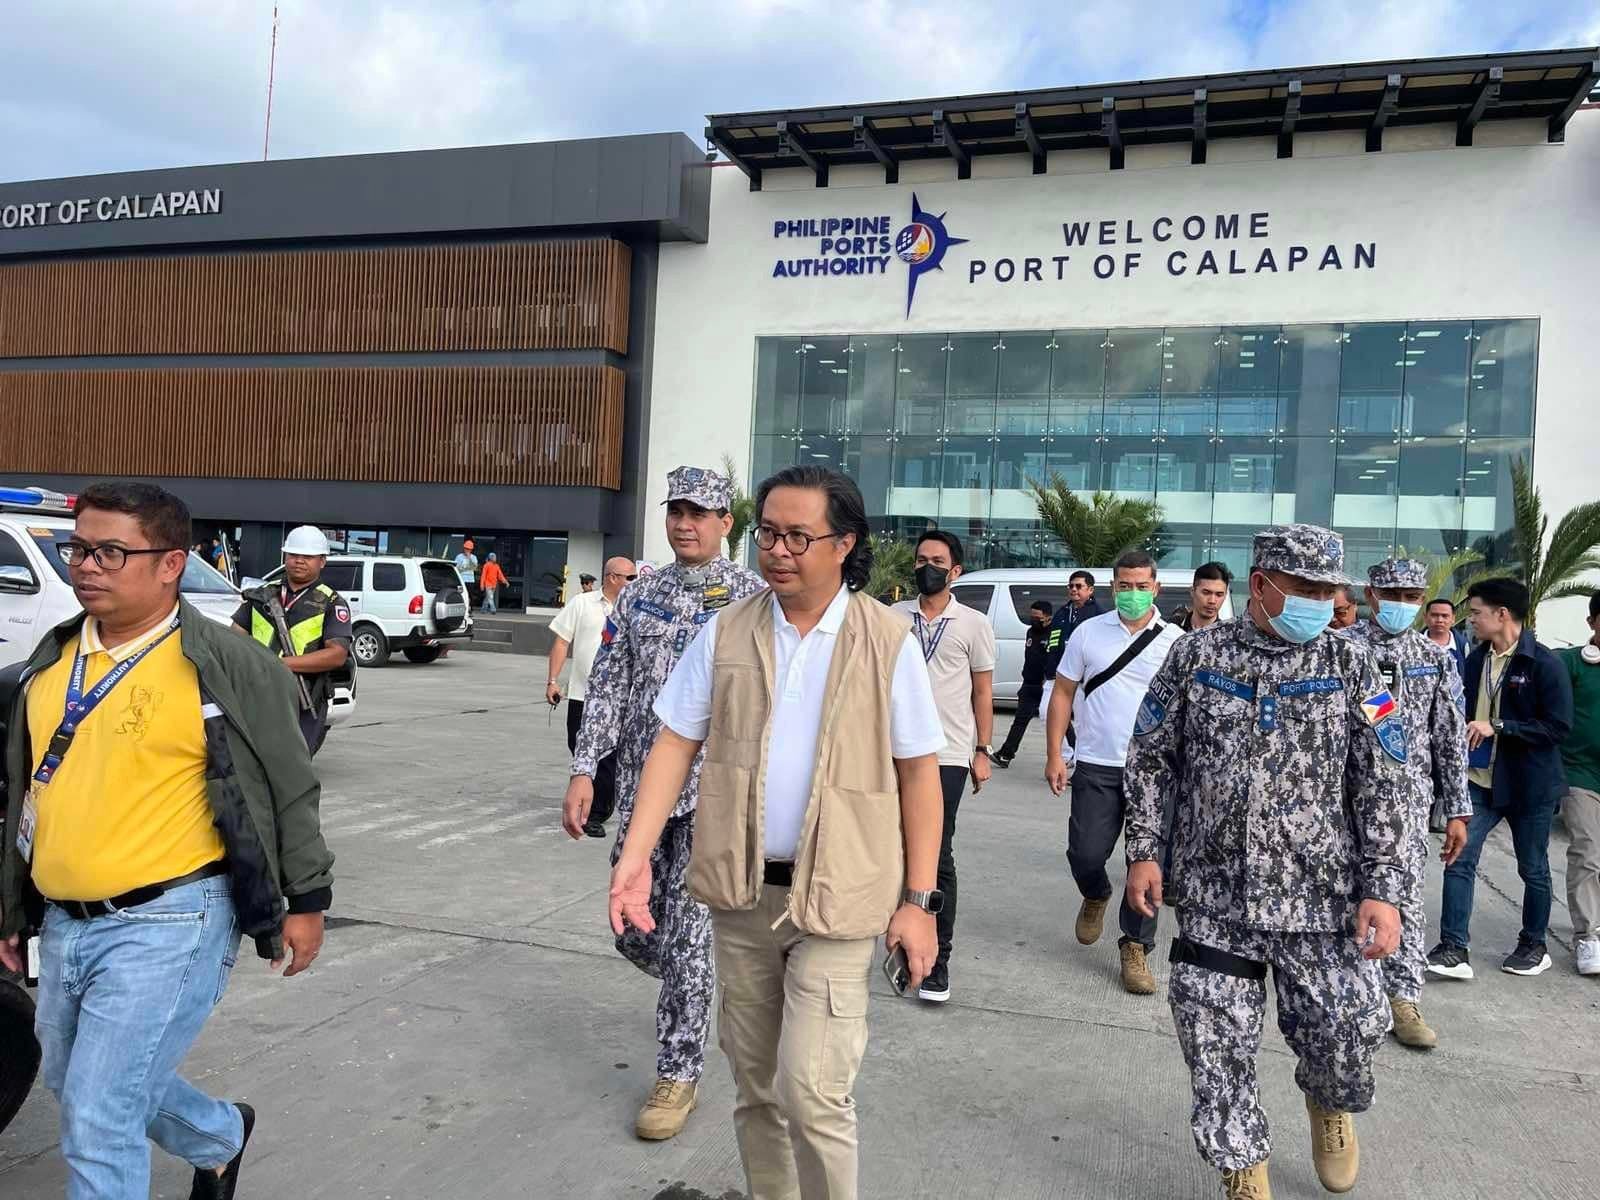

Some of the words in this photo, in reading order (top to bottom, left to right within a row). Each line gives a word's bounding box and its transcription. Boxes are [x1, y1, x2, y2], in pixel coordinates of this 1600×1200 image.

[0, 202, 50, 228] ORT
[58, 199, 90, 224] OF
[97, 188, 221, 222] CALAPAN
[773, 216, 891, 238] PHILIPPINE
[1062, 212, 1270, 246] WELCOME
[820, 236, 892, 255] PORTS
[772, 256, 891, 278] AUTHORITY
[969, 255, 1070, 283] PORT
[1094, 252, 1141, 279] OF
[1166, 242, 1376, 276] CALAPAN
[94, 662, 129, 699] AUTHORITY
[1209, 674, 1237, 691] RAYOS
[1283, 682, 1305, 694] PORT
[1310, 679, 1340, 690] POLICE
